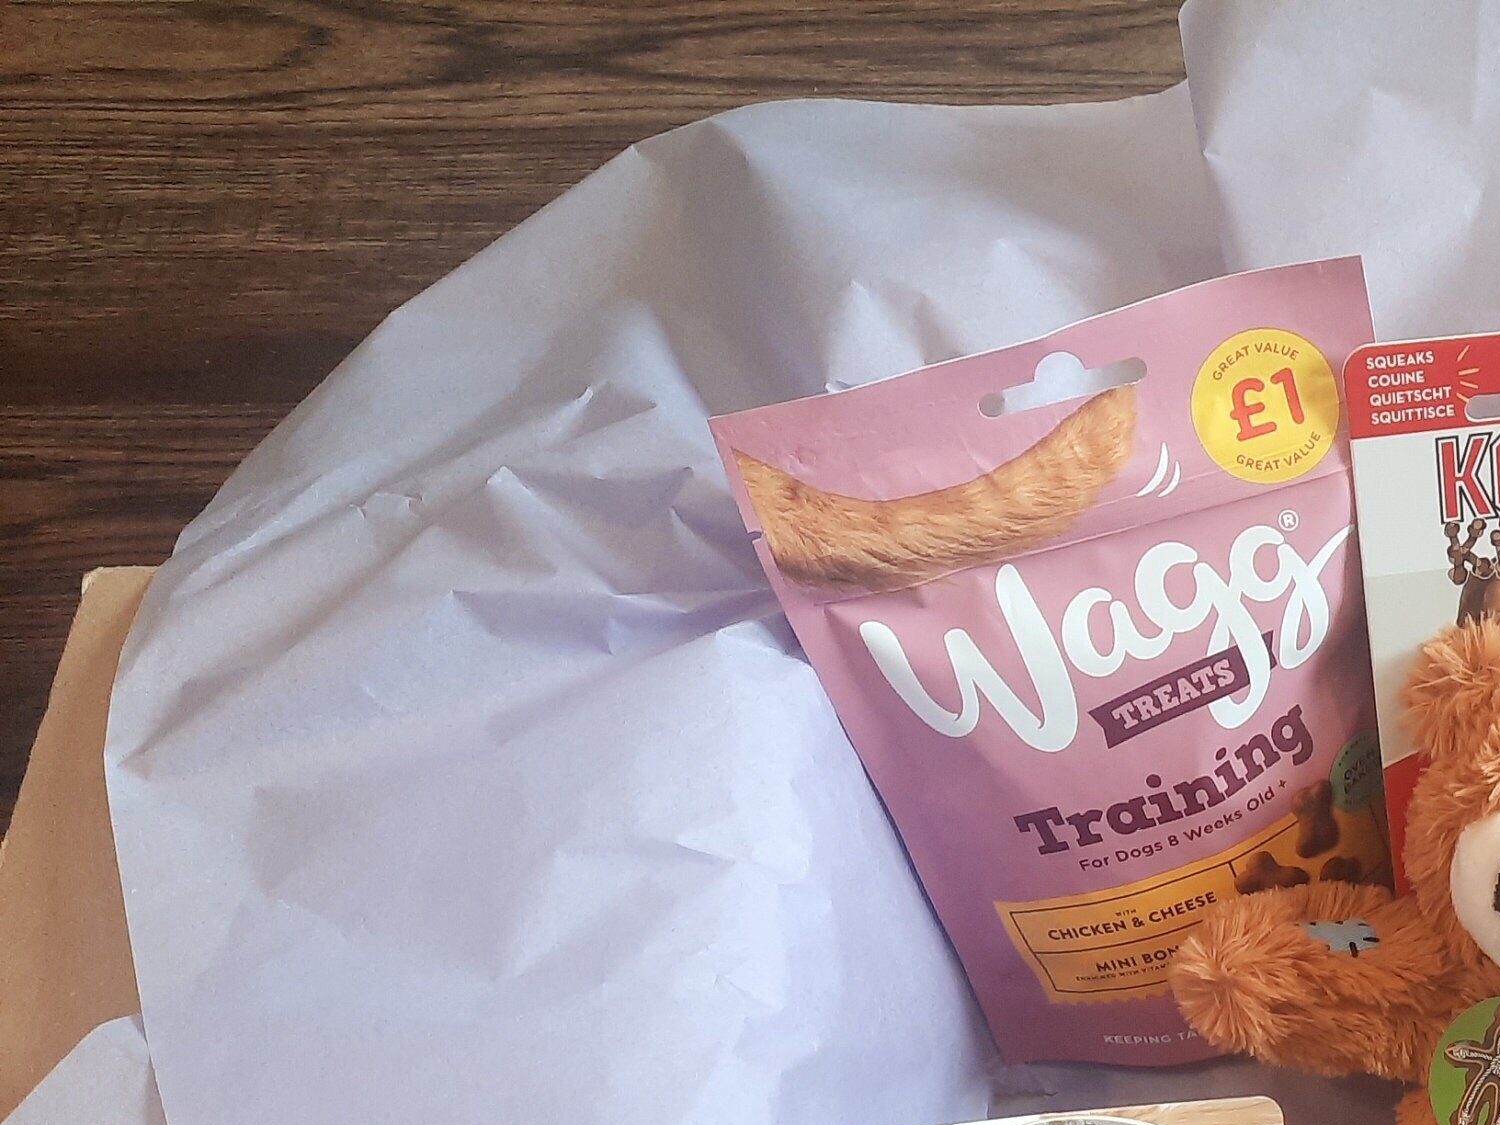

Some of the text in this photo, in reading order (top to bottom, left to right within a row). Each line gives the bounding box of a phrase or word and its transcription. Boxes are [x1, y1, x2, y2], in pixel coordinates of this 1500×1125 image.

[1212, 342, 1300, 381] GREAT VALUE
[1366, 351, 1434, 370] SQUEAKS
[1368, 371, 1425, 388] COUINE
[1230, 367, 1305, 442] £1
[1369, 386, 1452, 407] QUIETSCHT
[1371, 405, 1455, 425] SQUITTISCE
[1236, 431, 1321, 471] GREAT VALUE
[859, 524, 1354, 753] Wagg
[1111, 660, 1236, 730] TREATS
[1013, 704, 1314, 856] Training
[1079, 855, 1113, 873] For
[1115, 840, 1163, 864] Dogs
[1168, 833, 1180, 848] 8
[1183, 808, 1242, 841] Weeks
[1246, 786, 1276, 812] Old
[1048, 891, 1217, 941] CHICKEN & CHEESE
[1115, 907, 1137, 918] WITH
[1096, 956, 1138, 973] MINI
[1103, 1033, 1172, 1046] KEEPING
